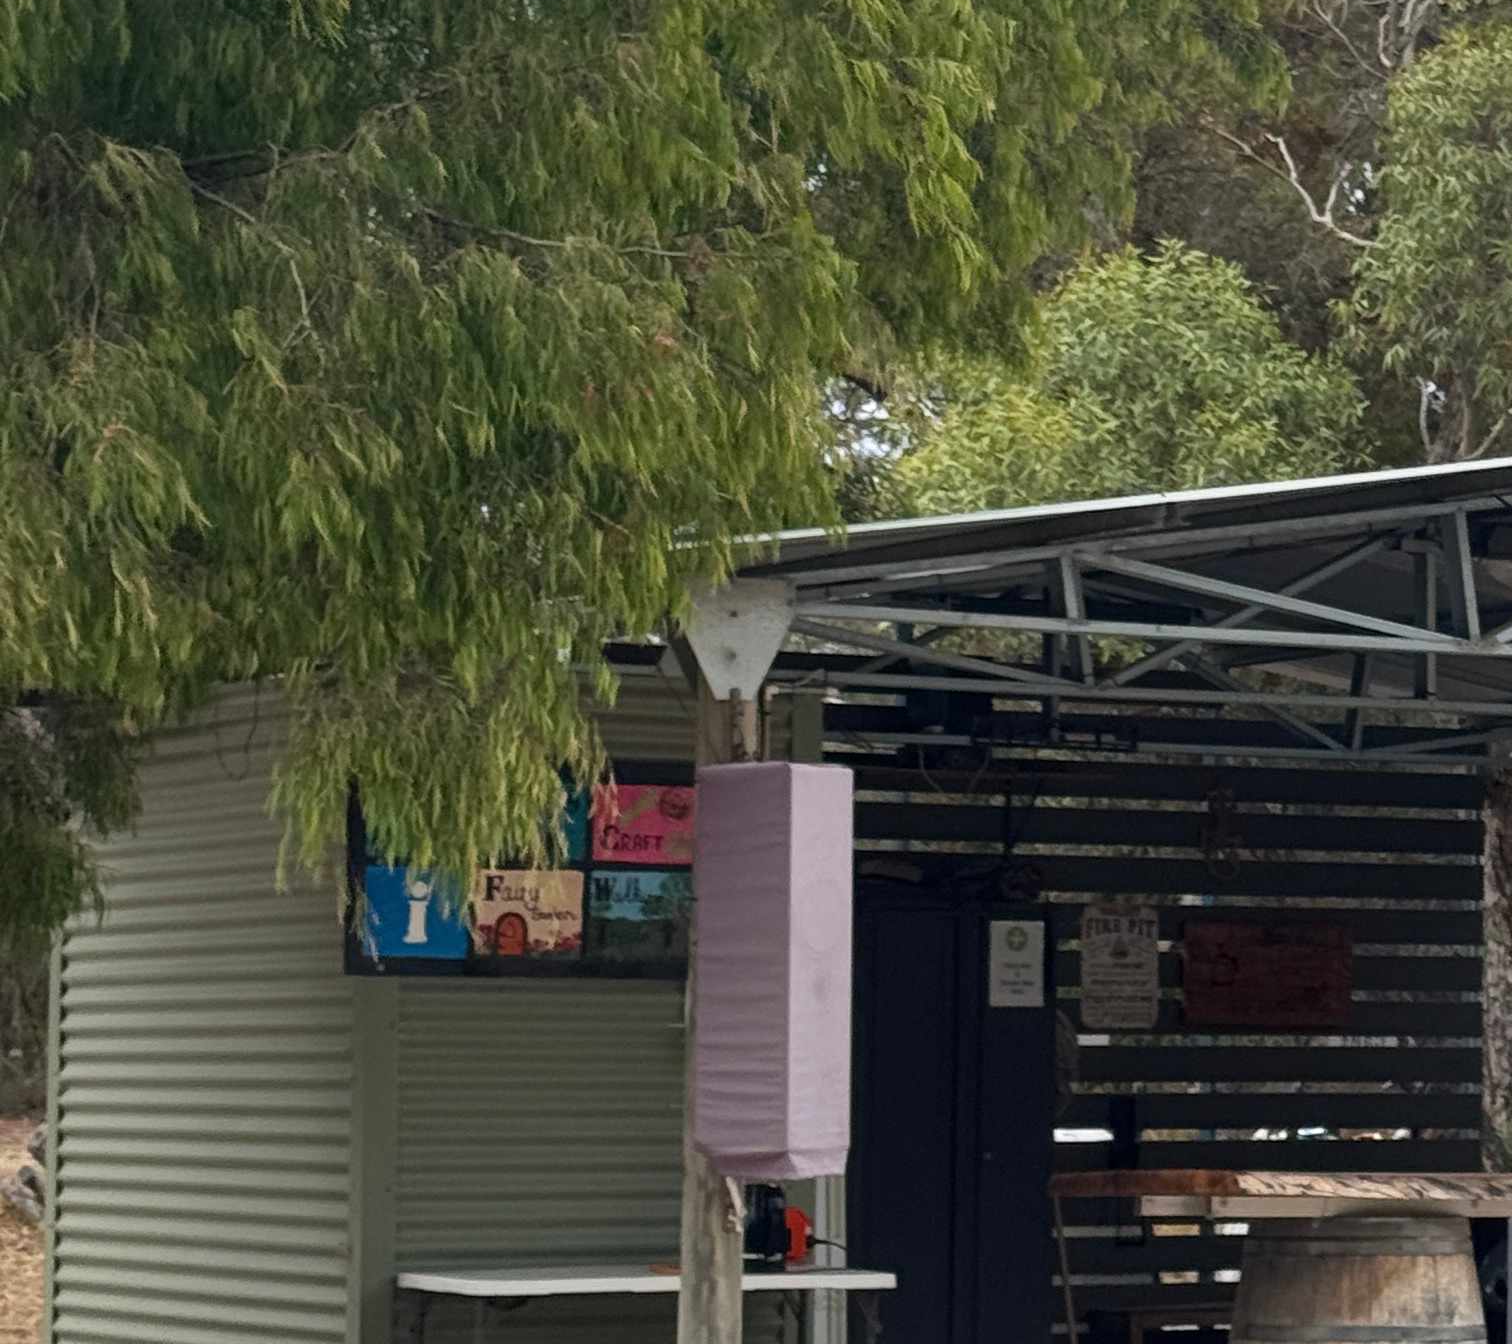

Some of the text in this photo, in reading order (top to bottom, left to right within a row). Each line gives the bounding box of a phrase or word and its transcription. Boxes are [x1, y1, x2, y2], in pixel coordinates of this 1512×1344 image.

[601, 825, 664, 851] CRAFT
[483, 875, 539, 911] Fairy
[1086, 918, 1156, 938] FIRE PIT
